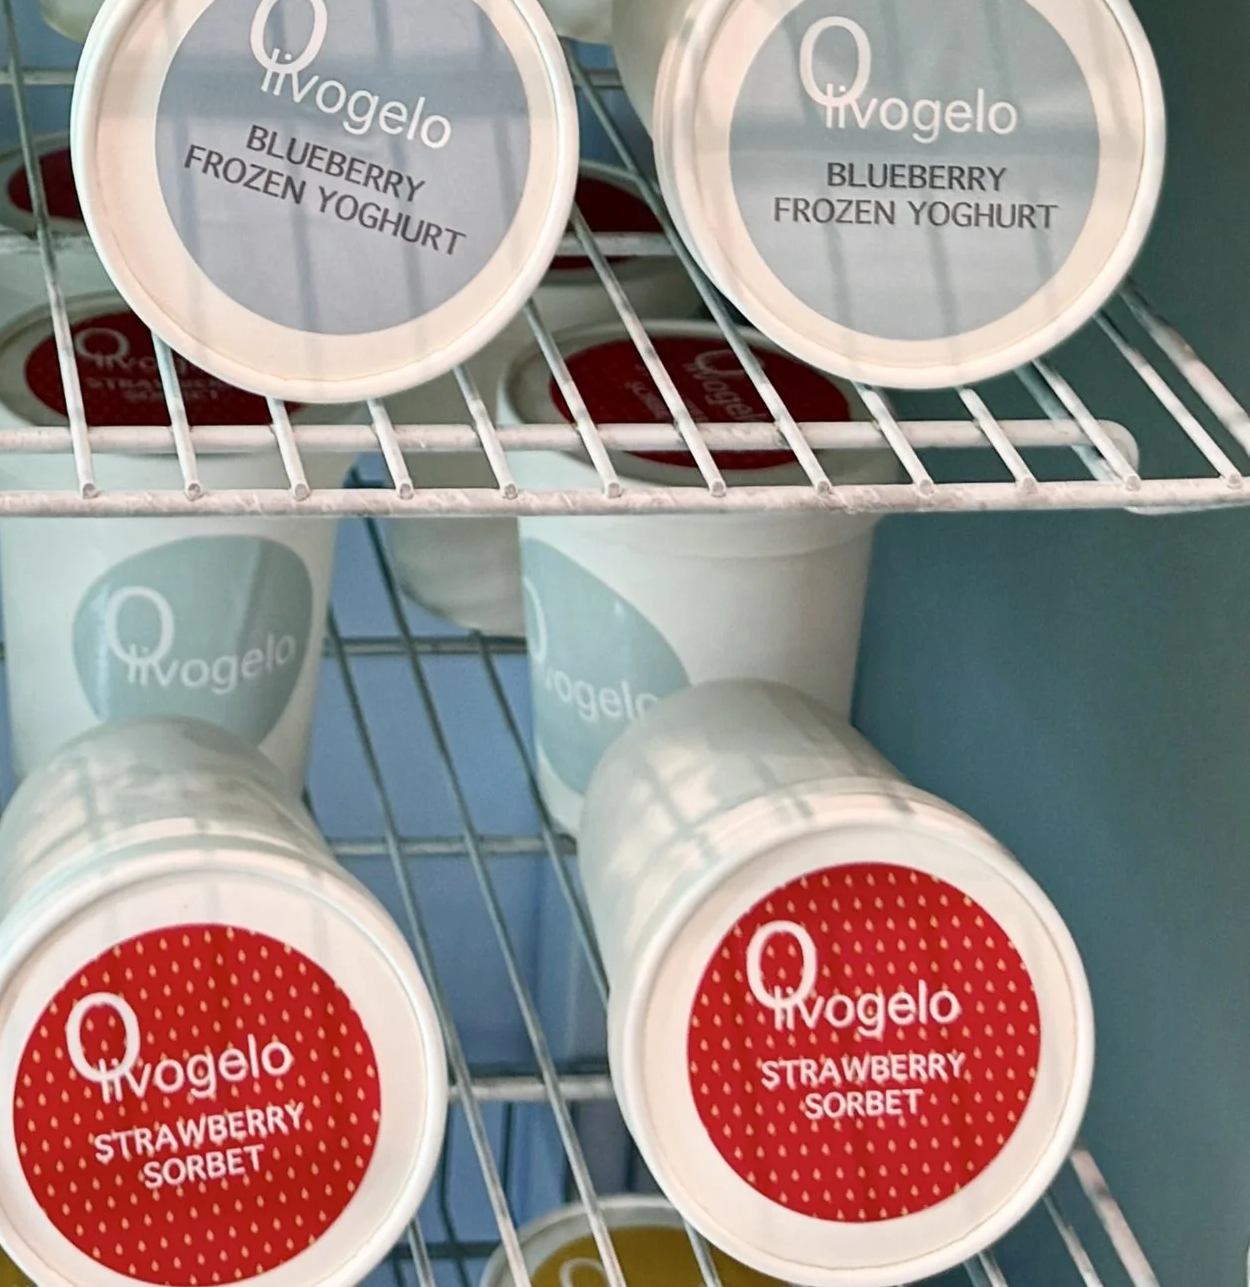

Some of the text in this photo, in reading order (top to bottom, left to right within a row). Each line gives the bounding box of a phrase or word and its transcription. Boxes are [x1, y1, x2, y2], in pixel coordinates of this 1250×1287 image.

[245, 125, 427, 203] BLUEBERRY
[826, 161, 1007, 193] BLUEBERRY
[184, 143, 467, 256] FROZEN YOGHURT
[772, 195, 1060, 232] FROZEN YOGHURT
[760, 1050, 966, 1087] STRAWBERRY
[804, 1087, 923, 1121] SORBET
[94, 1099, 307, 1164] STRAWBERRY
[143, 1144, 266, 1189] SORBET
